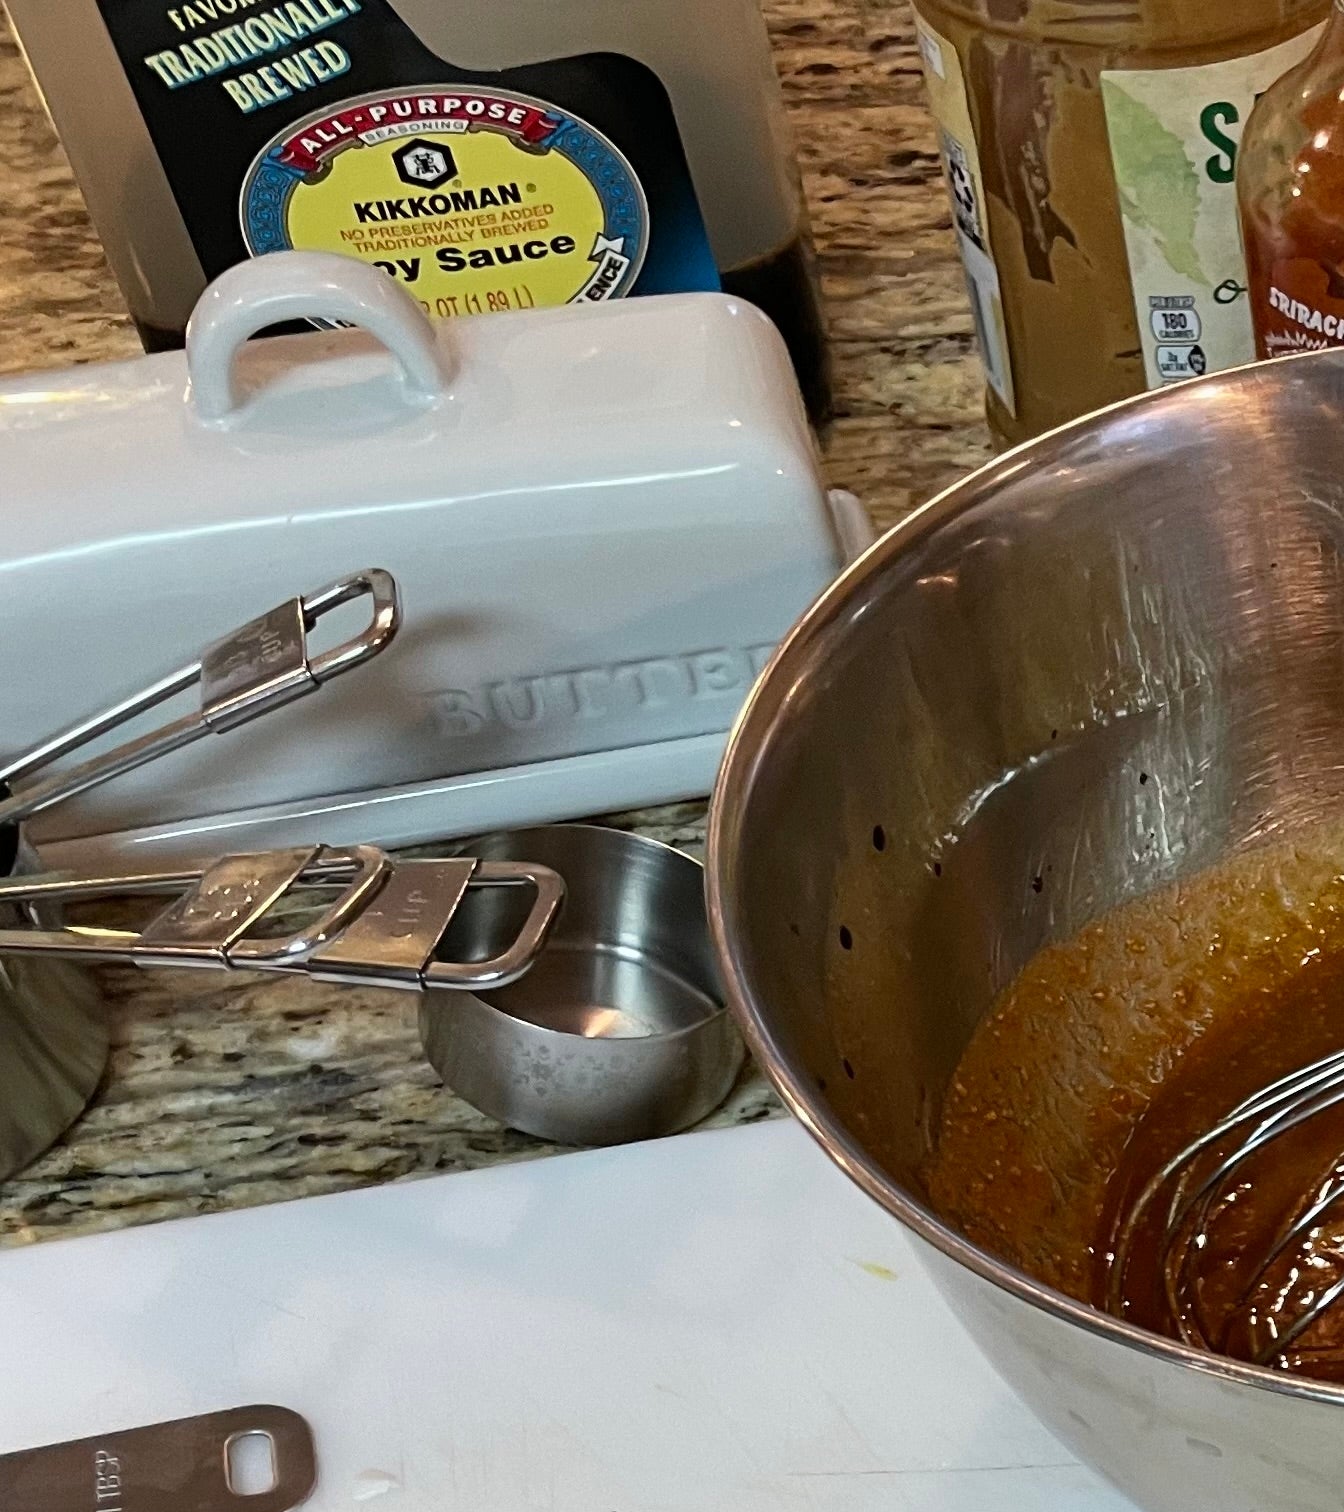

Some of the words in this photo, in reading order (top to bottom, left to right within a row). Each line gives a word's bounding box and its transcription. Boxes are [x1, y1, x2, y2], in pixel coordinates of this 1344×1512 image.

[222, 40, 351, 114] BREWED
[299, 98, 527, 154] ALL-PURPOSE
[364, 120, 465, 142] SEASONING
[340, 229, 364, 242] NO
[368, 213, 498, 240] PRESERVATIVES
[501, 203, 555, 223] ADDED
[353, 182, 522, 223] KIKKOMAN
[352, 229, 475, 254] TRADITIONALLY
[481, 217, 550, 240] BREWED
[371, 256, 421, 283] oy
[435, 235, 576, 273] Sauce
[95, 1449, 122, 1504] TBSP
